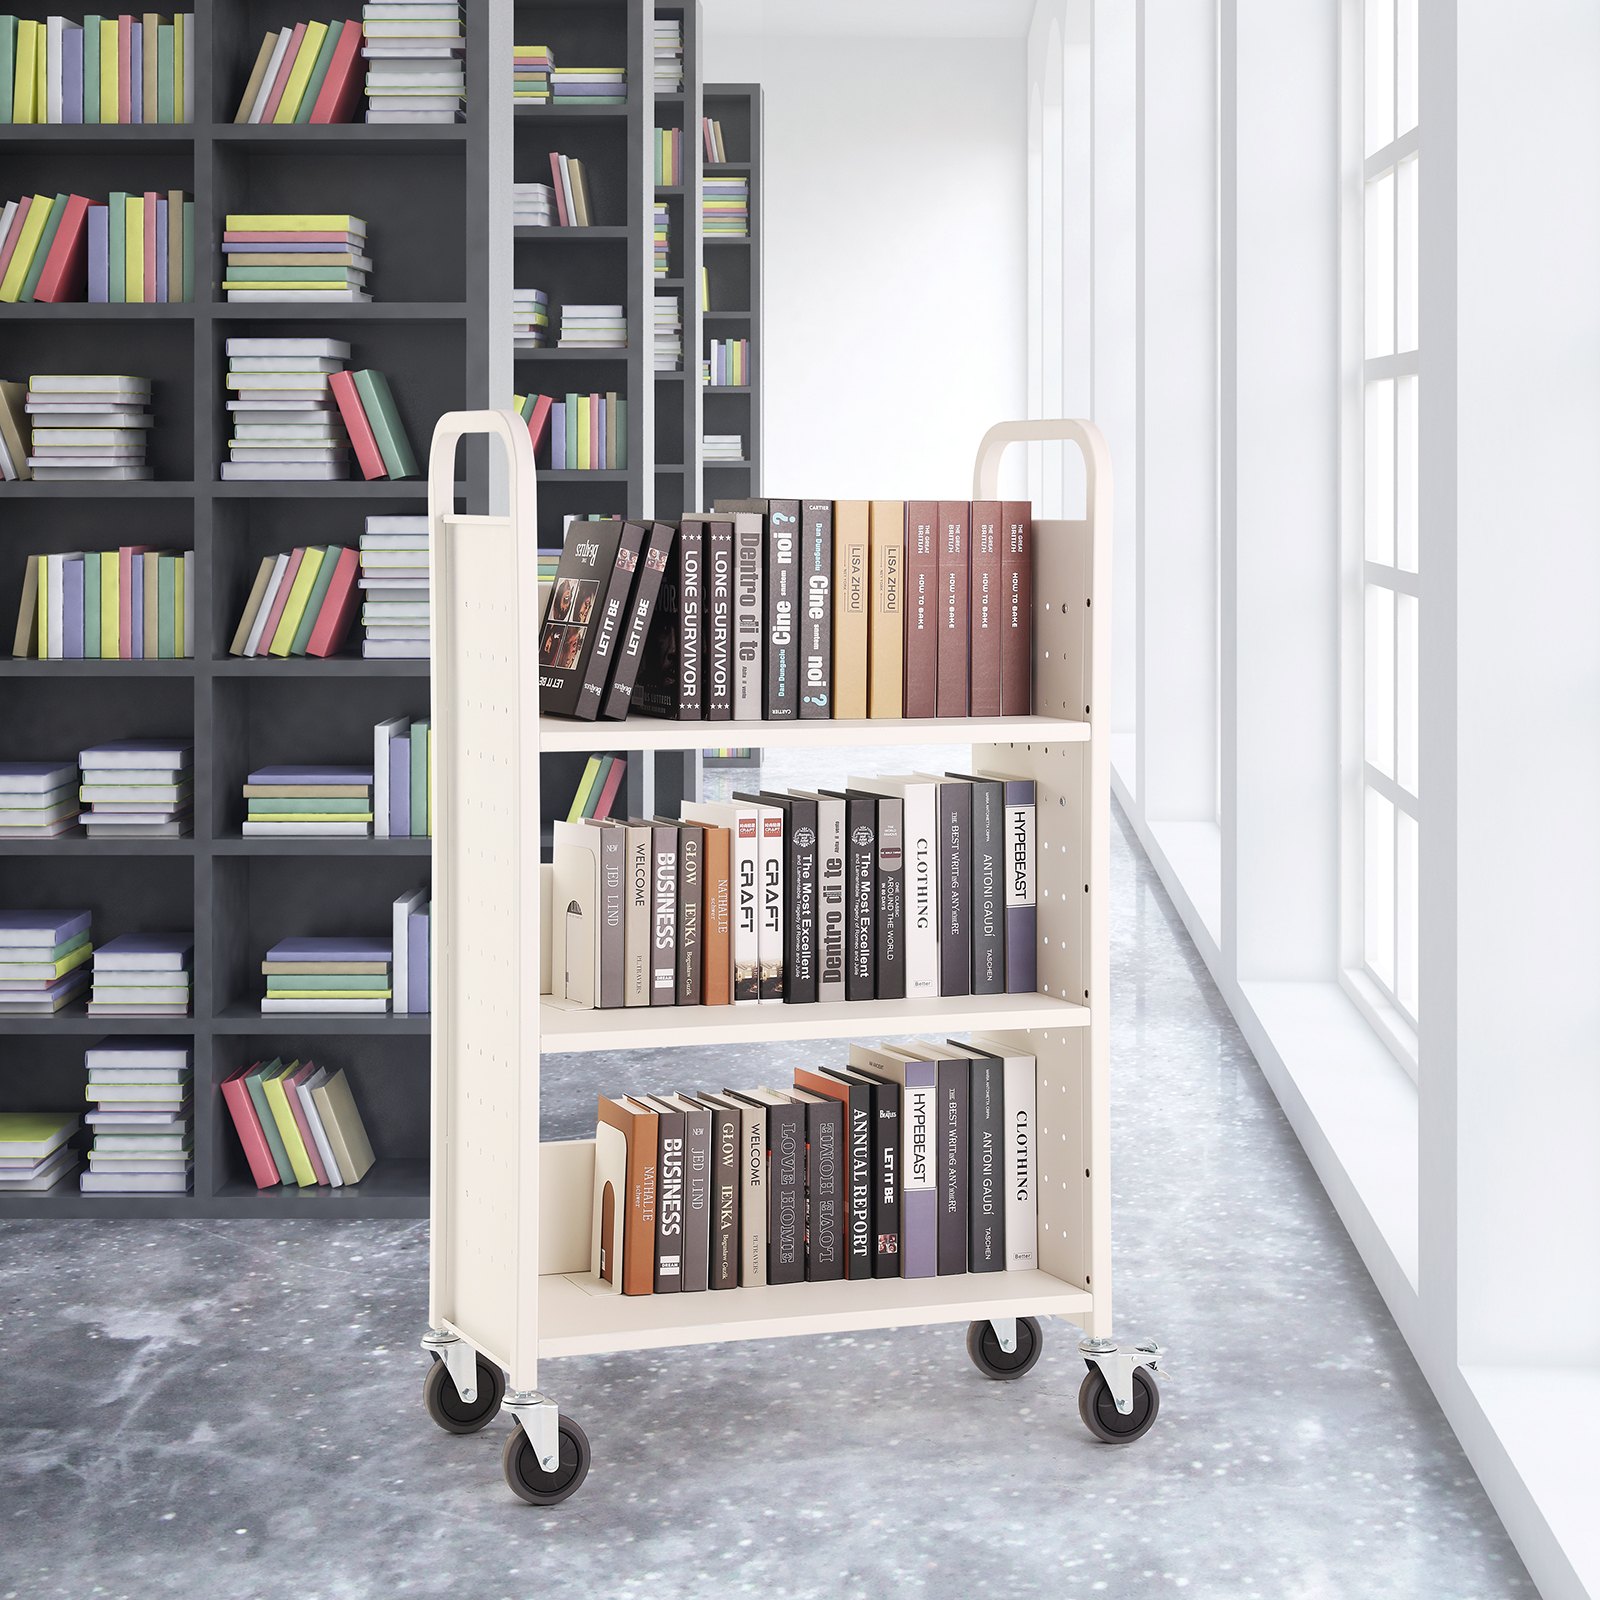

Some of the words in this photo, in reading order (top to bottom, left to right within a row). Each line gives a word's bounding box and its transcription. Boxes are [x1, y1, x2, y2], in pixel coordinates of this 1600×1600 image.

[773, 512, 795, 525] ?
[773, 532, 792, 563] noi
[852, 548, 860, 574] LISA
[888, 549, 896, 574] LISA
[685, 551, 697, 597] LONE
[715, 551, 727, 597] LONE
[740, 533, 760, 606] Dentro
[607, 599, 619, 617] BE
[637, 599, 649, 617] BE
[809, 576, 828, 619] Cine
[851, 576, 860, 609] ZHOU
[887, 577, 896, 609] ZHOU
[919, 595, 924, 605] TO
[949, 595, 955, 604] TO
[982, 594, 988, 604] TO
[1012, 594, 1018, 603] TO
[604, 617, 614, 631] IT
[633, 617, 644, 631] IT
[739, 615, 759, 633] di
[772, 601, 791, 644] Cine
[597, 632, 610, 656] LET
[627, 632, 640, 656] LET
[684, 602, 697, 696] SURVIVOR
[714, 602, 727, 696] SURVIVOR
[739, 641, 758, 661] te
[539, 676, 547, 686] BE
[546, 678, 554, 688] IT
[553, 678, 564, 689] LET
[808, 656, 826, 686] noi
[804, 694, 827, 706] ?
[685, 841, 697, 885] GLOW
[802, 854, 812, 878] The
[824, 858, 842, 878] te
[860, 852, 871, 877] The
[1014, 812, 1026, 899] HYPEBEAST
[606, 864, 618, 887] JED
[635, 843, 645, 906] WELCOME
[917, 838, 928, 928] CLOTHING
[984, 854, 993, 897] ANTONI
[608, 895, 618, 926] LIND
[656, 853, 675, 949] BUSINESS
[718, 880, 727, 933] NATHALIE
[741, 860, 754, 932] CRAFT
[765, 859, 779, 932] CRAFT
[802, 883, 812, 915] Most
[823, 885, 842, 903] di
[860, 880, 871, 913] Most
[685, 903, 696, 947] IENKA
[984, 901, 995, 936] GAUDÍ
[801, 919, 811, 979] Excellent
[823, 911, 842, 983] Dentro
[860, 917, 870, 978] Excellent
[949, 1102, 957, 1127] BEST
[722, 1123, 734, 1167] GLOW
[751, 1123, 760, 1186] WELCOME
[781, 1123, 796, 1185] LOVE
[854, 1109, 867, 1181] ANNUAL
[914, 1094, 925, 1182] HYPEBEAST
[983, 1132, 992, 1175] ANTONI
[691, 1148, 704, 1171] JED
[819, 1123, 834, 1195] HOME
[885, 1148, 893, 1170] LET
[1017, 1111, 1028, 1200] CLOTHING
[643, 1167, 654, 1221] NATHALIE
[662, 1139, 682, 1235] BUSINESS
[692, 1179, 703, 1209] LIND
[885, 1173, 893, 1184] IT
[721, 1185, 733, 1230] IENKA
[884, 1187, 893, 1204] BE
[983, 1178, 994, 1215] GAUDÍ
[780, 1190, 795, 1263] HOME
[819, 1200, 834, 1262] LOVE
[853, 1185, 867, 1256] REPORT
